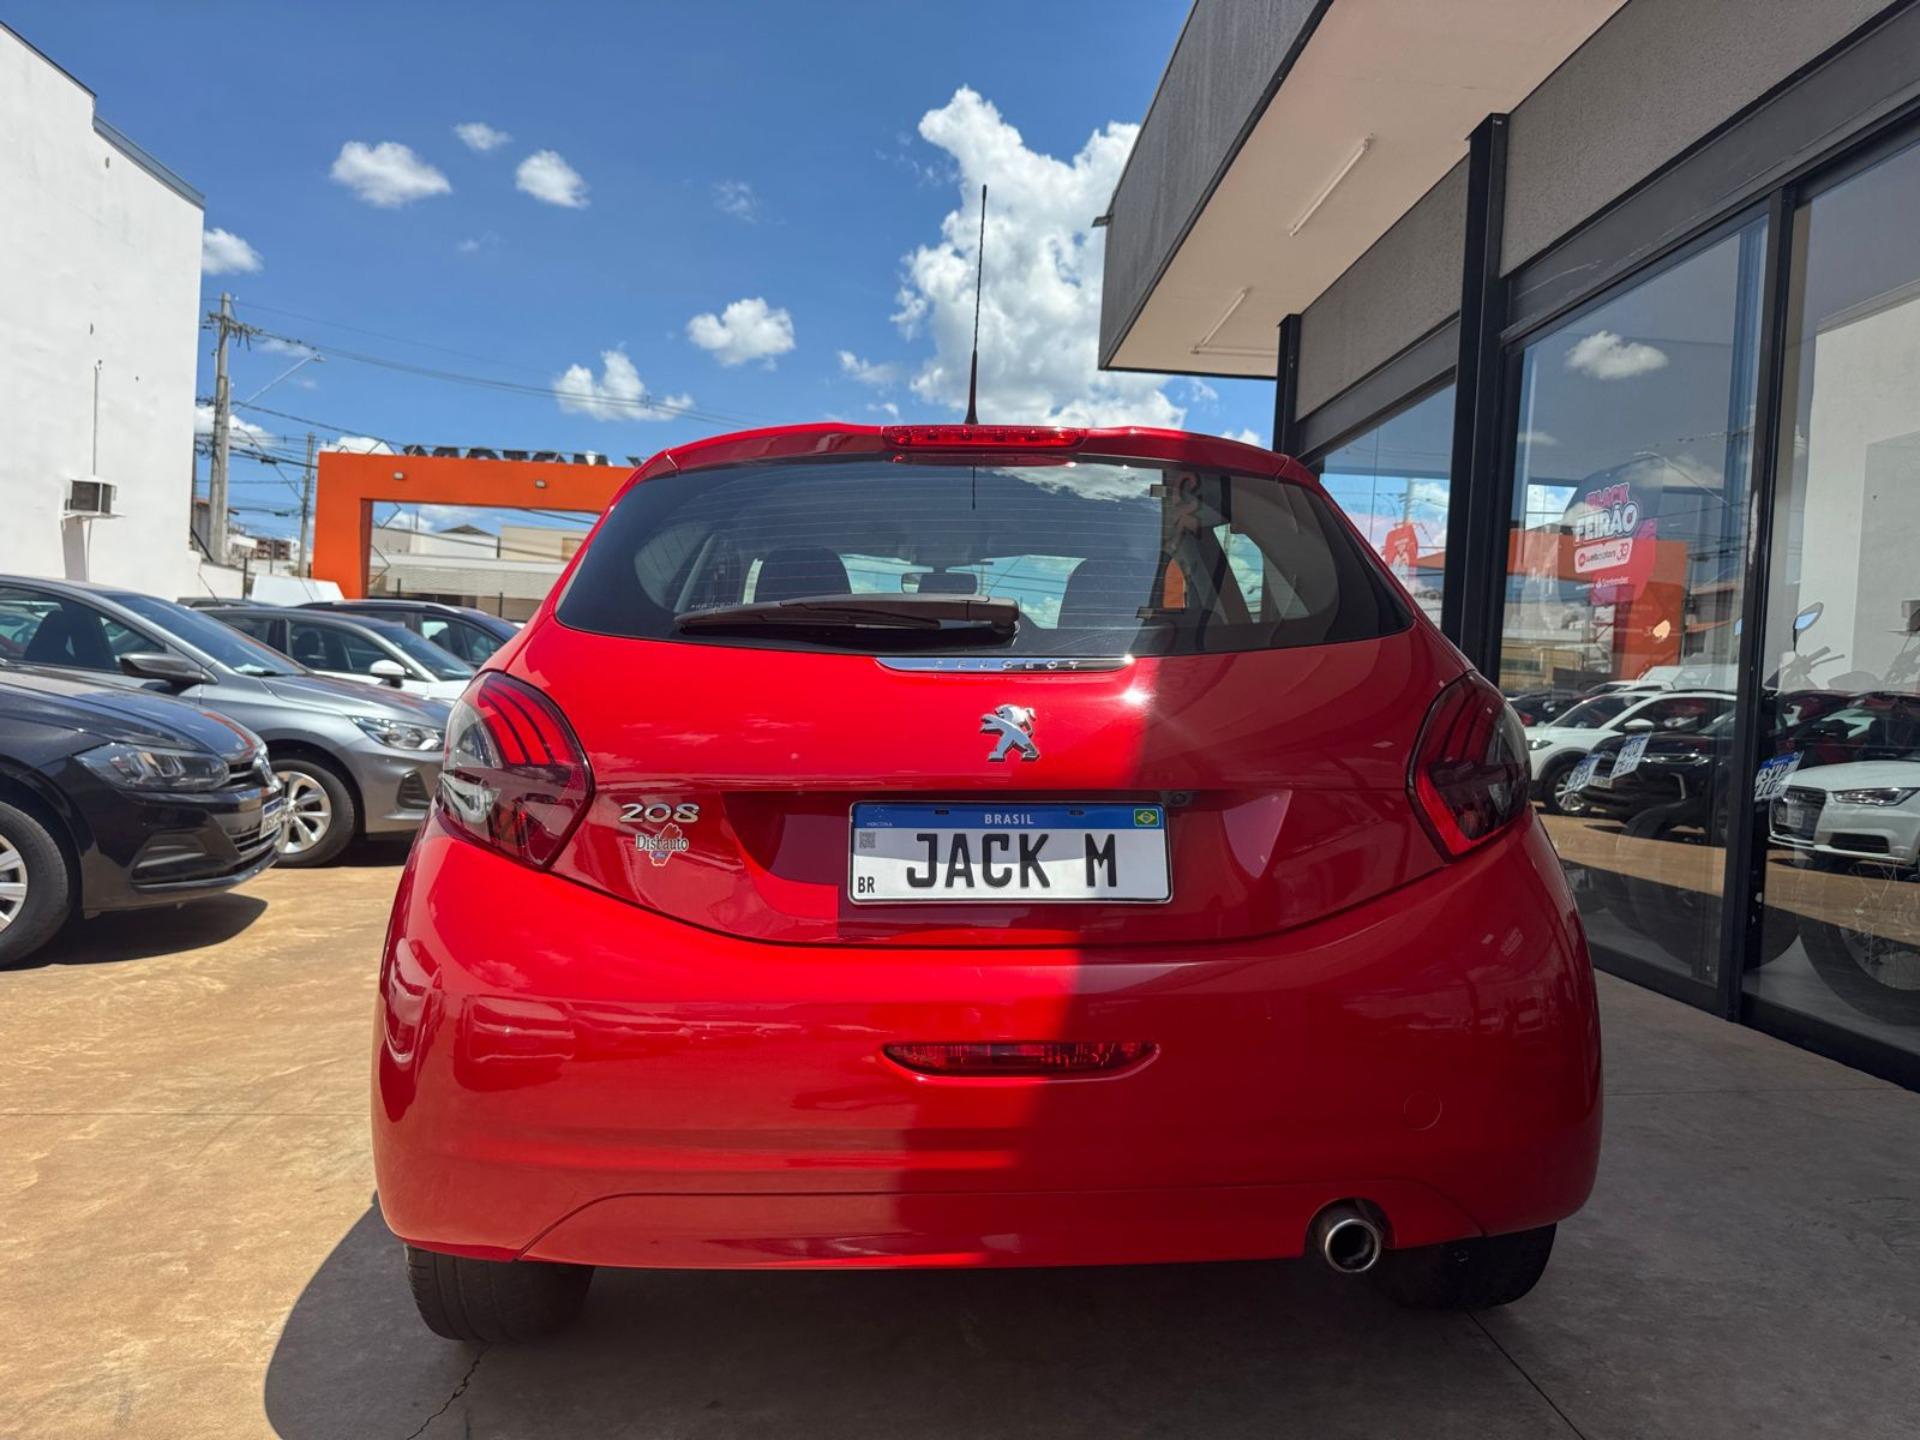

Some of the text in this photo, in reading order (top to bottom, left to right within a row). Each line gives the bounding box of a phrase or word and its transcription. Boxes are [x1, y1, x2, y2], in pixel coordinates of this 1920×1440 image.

[1573, 502, 1638, 543] FEIRÃO
[620, 803, 700, 823] 208
[984, 813, 1035, 826] BRASIL
[906, 833, 1118, 888] JACK M
[857, 876, 876, 894] BR
